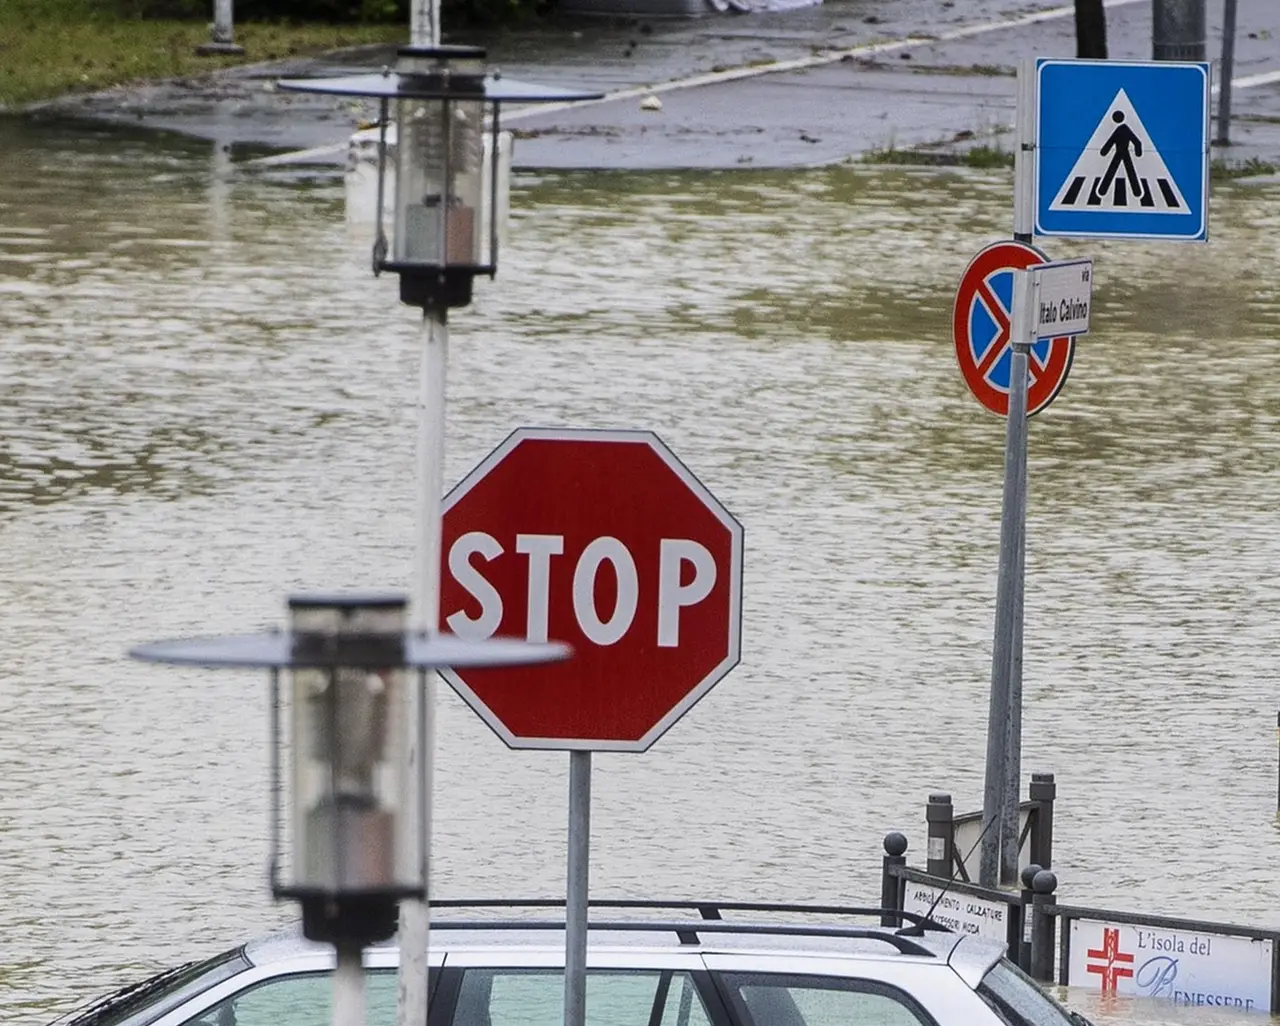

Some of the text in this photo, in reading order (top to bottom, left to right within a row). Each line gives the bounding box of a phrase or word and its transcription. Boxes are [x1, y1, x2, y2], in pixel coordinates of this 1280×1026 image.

[1081, 267, 1089, 282] via
[1040, 297, 1087, 324] Italo Calvino
[446, 531, 717, 647] STOP
[1138, 931, 1211, 956] L'isola del
